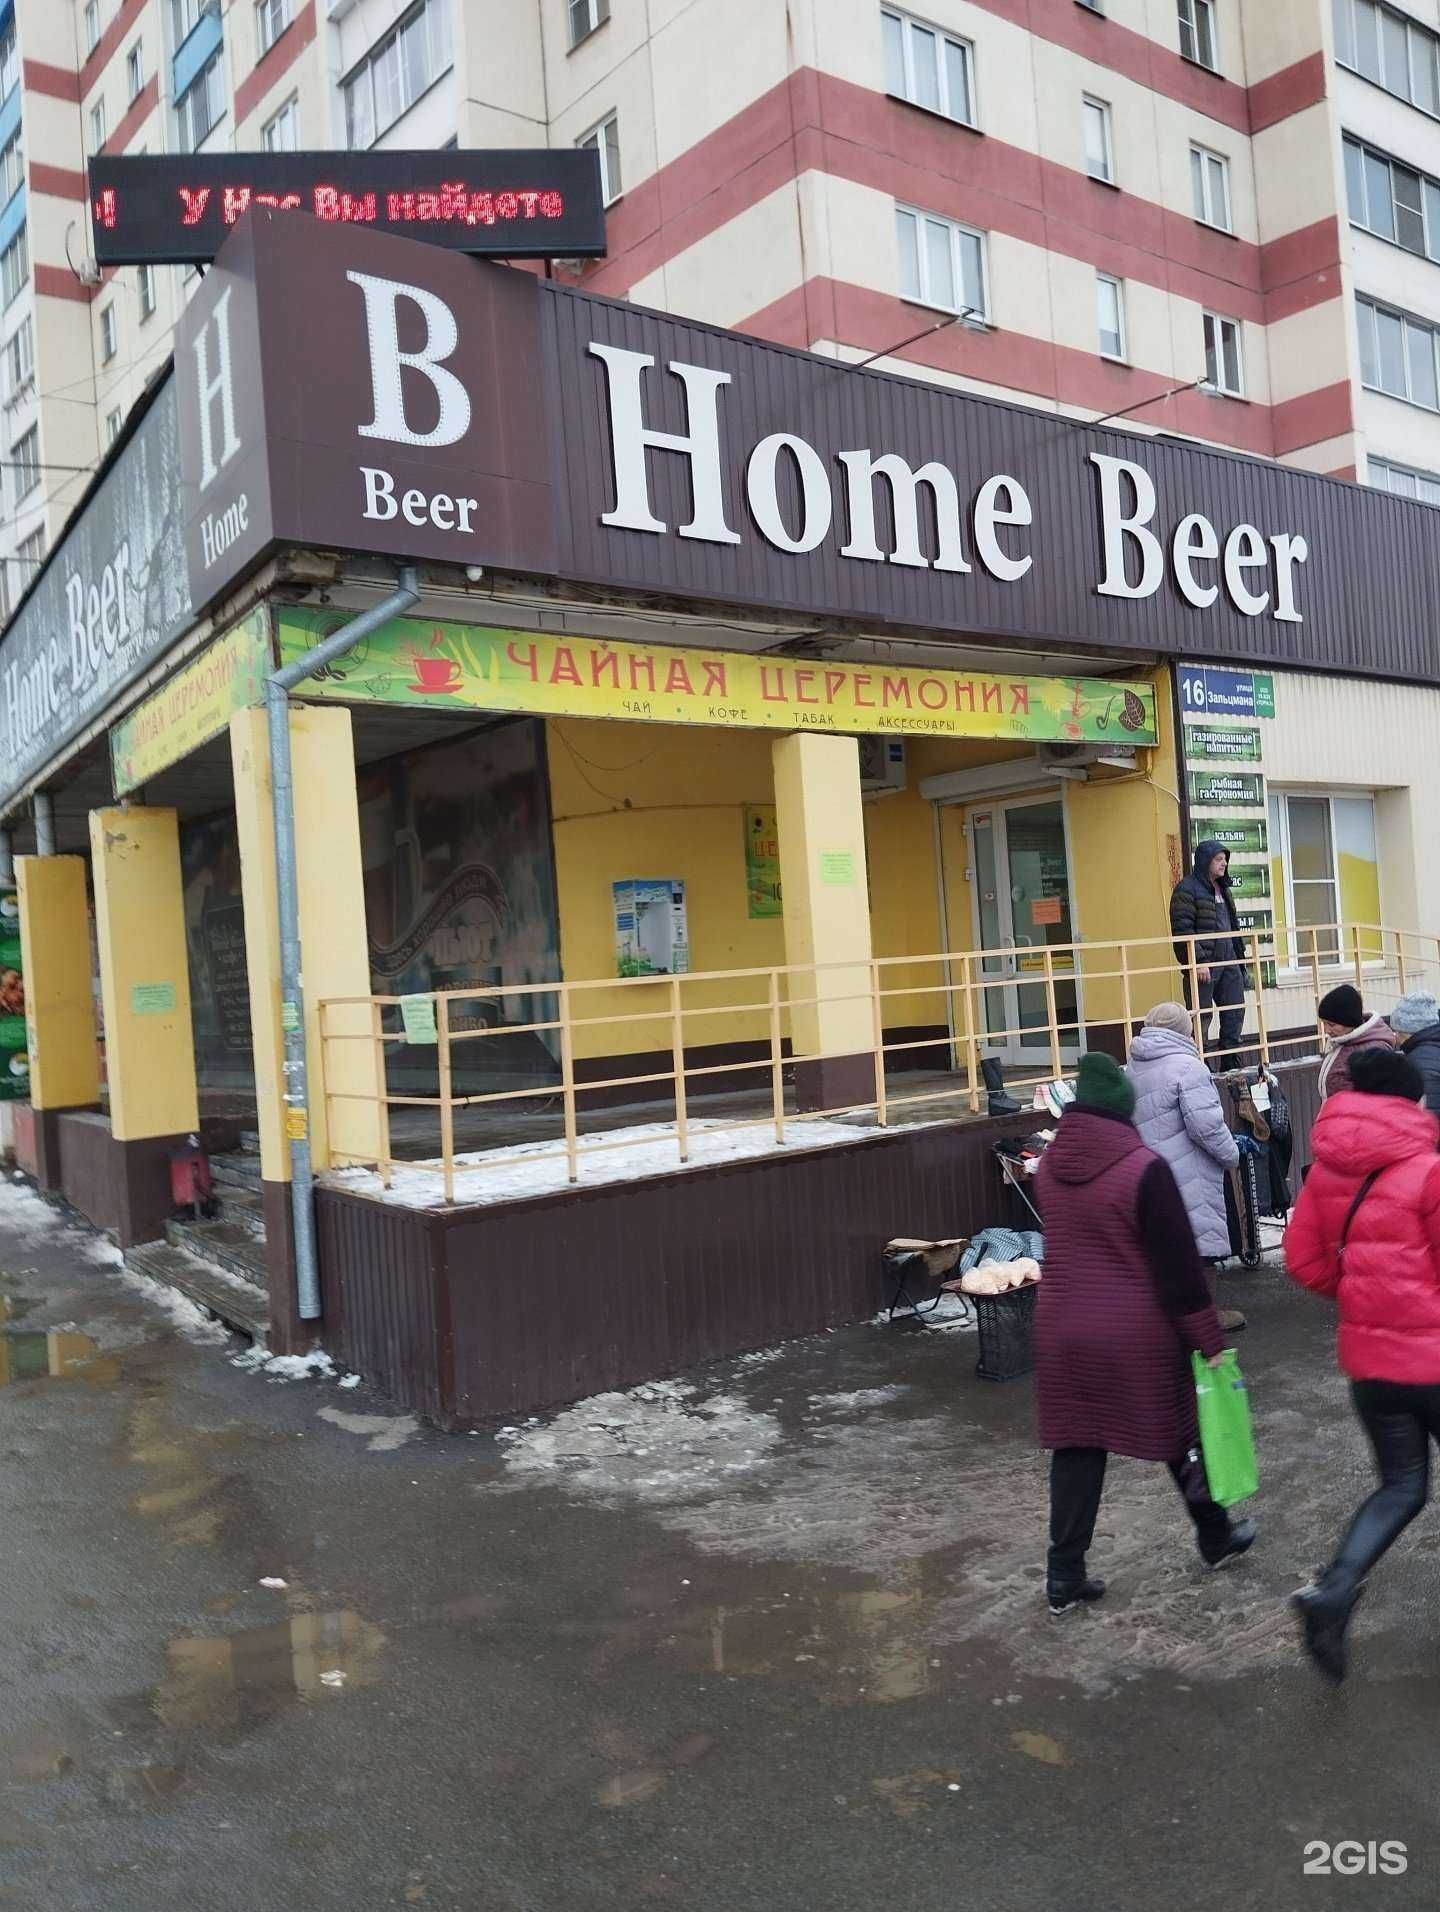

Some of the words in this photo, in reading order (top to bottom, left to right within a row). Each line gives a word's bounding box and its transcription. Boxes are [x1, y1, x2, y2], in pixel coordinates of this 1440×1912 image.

[178, 187, 210, 224] У
[314, 184, 375, 221] Вы
[347, 270, 471, 447] B
[193, 284, 241, 492] H
[589, 342, 1033, 582] Home
[1089, 452, 1308, 623] Beer
[359, 466, 478, 534] Beer
[200, 493, 249, 570] Home
[4, 637, 60, 760] Home
[66, 541, 131, 693] Beer
[506, 641, 729, 698] ЧАЙНАЯ
[760, 665, 1029, 715] ЦЕРЕМОНИЯ
[1182, 678, 1205, 706] 16
[1207, 691, 1254, 706] Зальцмана
[708, 706, 748, 720] КОФЕ
[793, 711, 835, 725] ТАБАК
[878, 716, 955, 731] АКСЕССУАРЫ
[1193, 732, 1253, 746] газированные
[1206, 742, 1242, 753] напитки
[1199, 788, 1255, 802] гастрономия
[1211, 777, 1243, 791] рыбная
[1214, 830, 1245, 841] кальян
